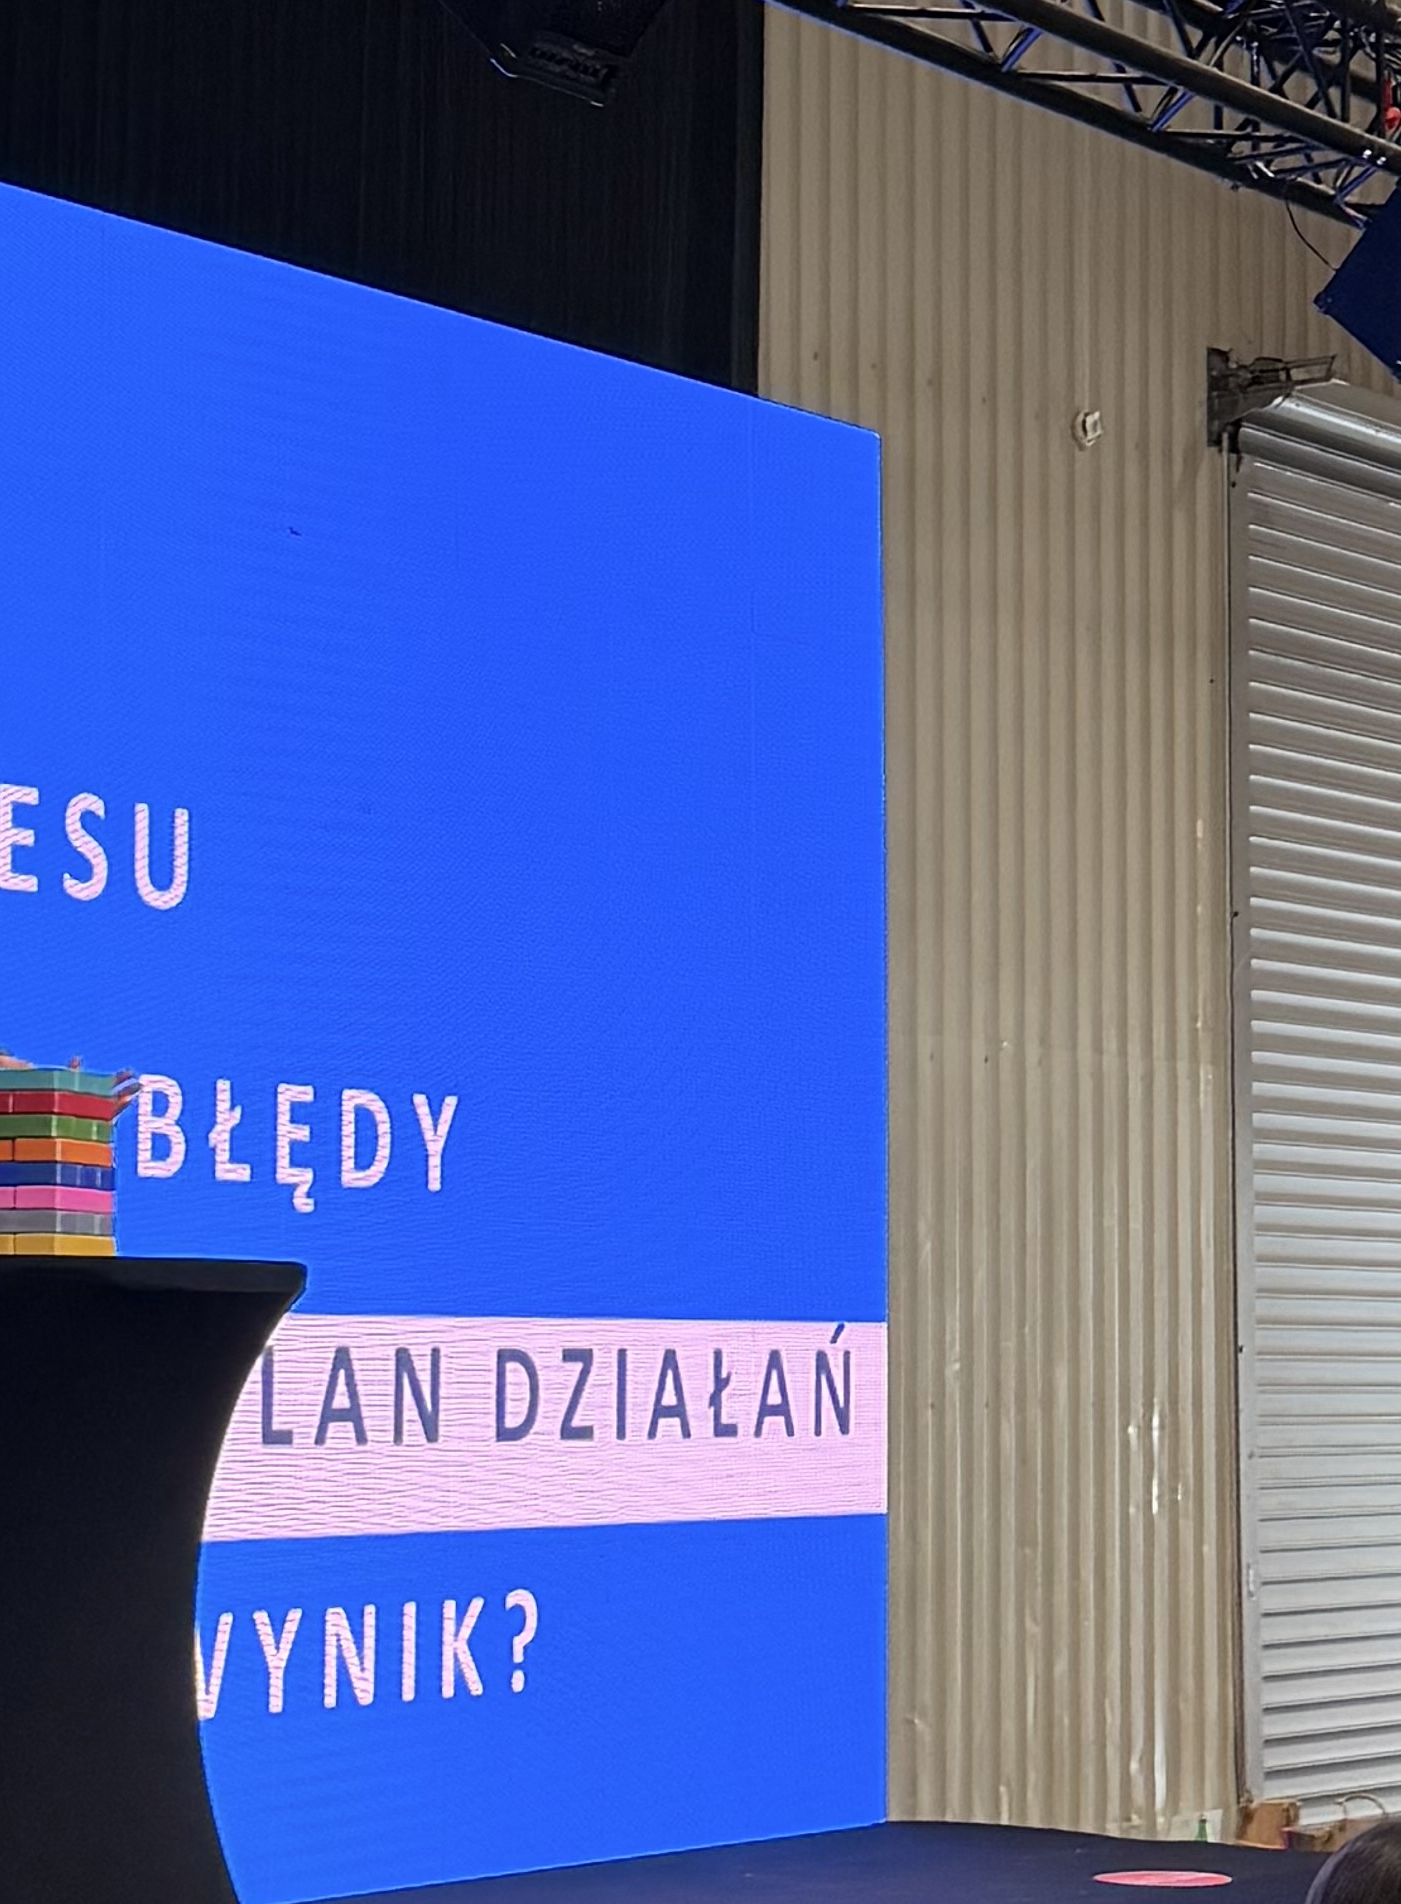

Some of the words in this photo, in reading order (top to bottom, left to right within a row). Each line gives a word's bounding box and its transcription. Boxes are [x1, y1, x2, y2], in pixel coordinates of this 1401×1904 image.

[134, 1072, 459, 1214] BŁĘDY
[260, 1345, 442, 1446] LAN
[494, 1322, 853, 1444] DZIAŁAŃ
